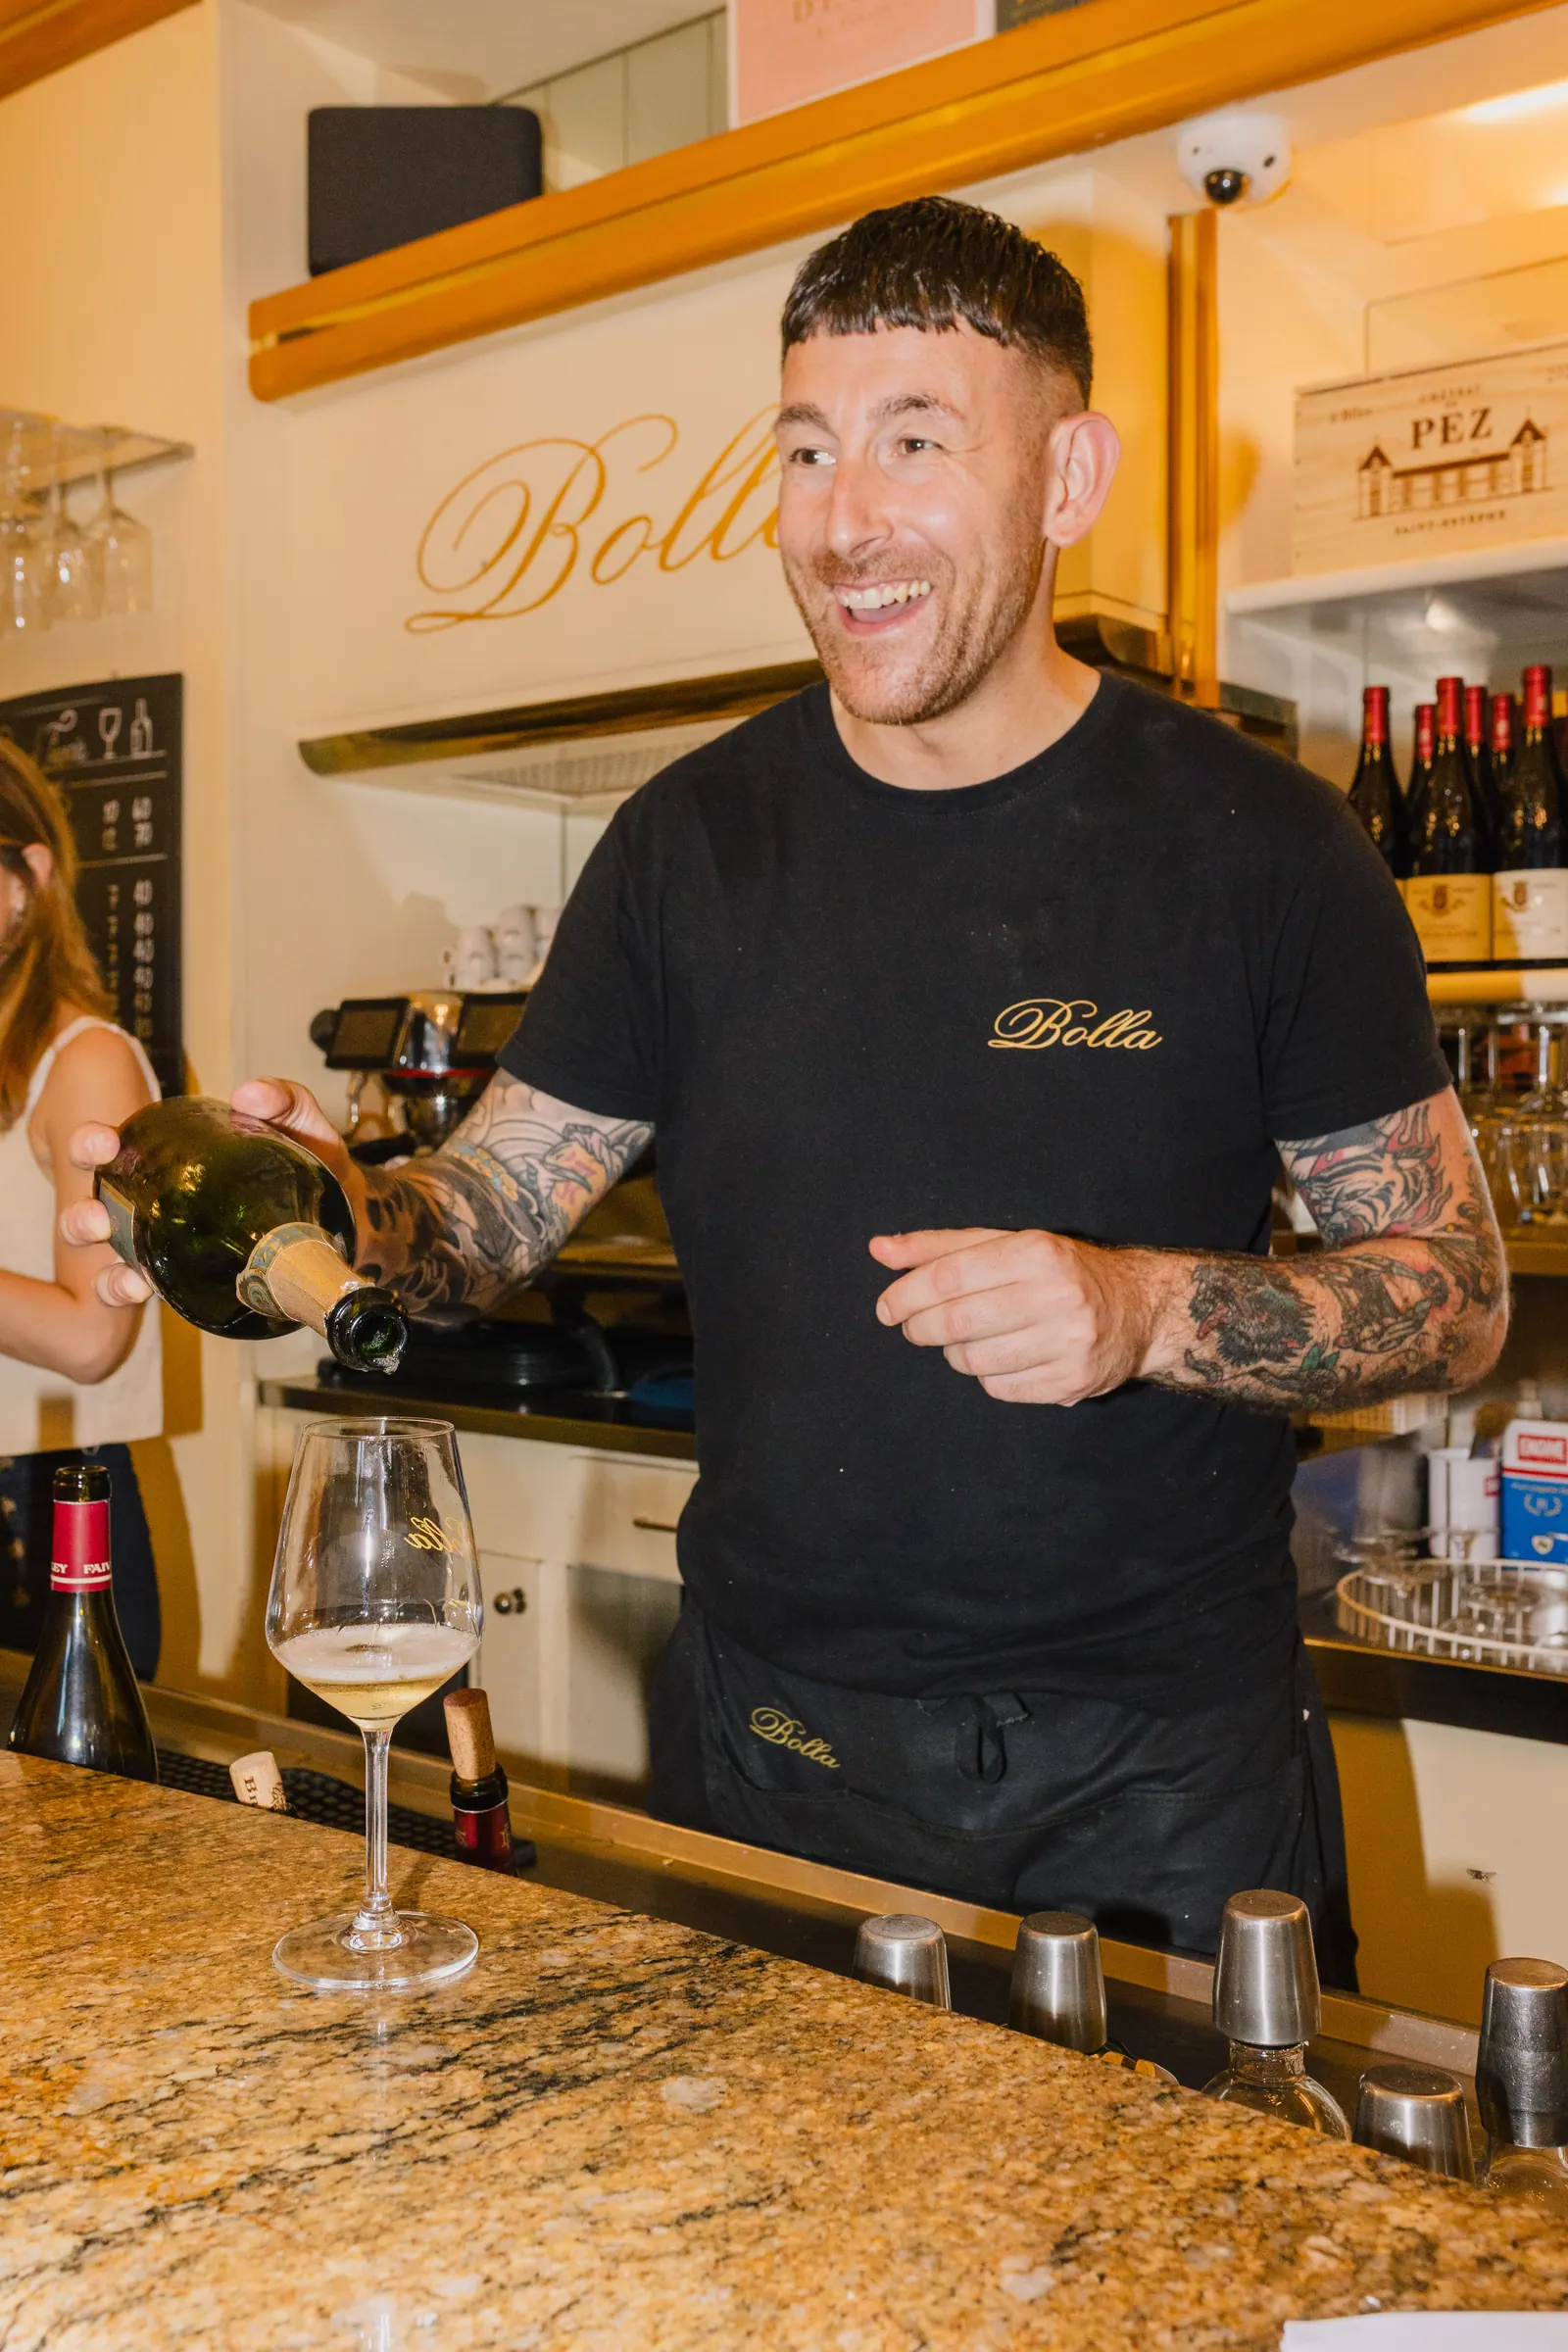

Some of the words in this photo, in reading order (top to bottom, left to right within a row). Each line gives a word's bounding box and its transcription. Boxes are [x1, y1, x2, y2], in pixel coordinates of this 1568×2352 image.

[1410, 407, 1493, 451] PEZ
[404, 403, 782, 634] Boll
[988, 998, 1163, 1050] Bolla
[749, 1706, 841, 1769] Bolla
